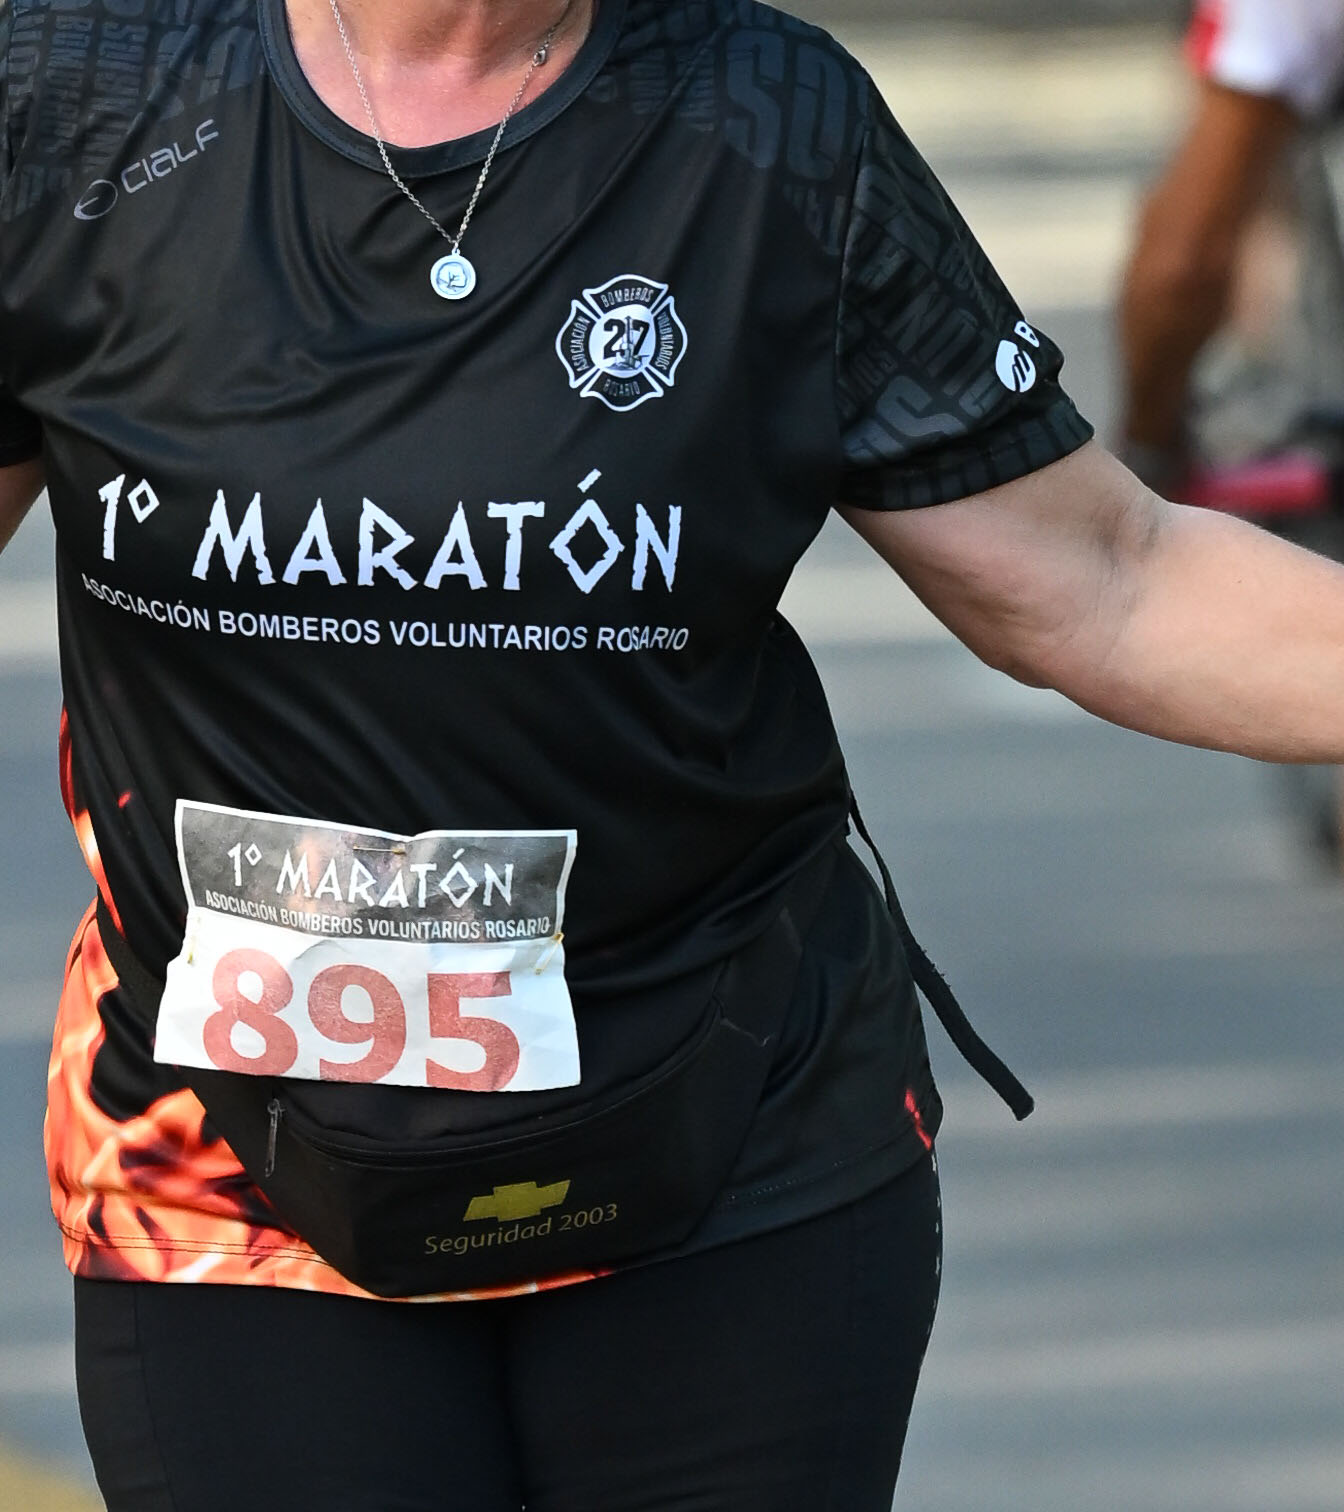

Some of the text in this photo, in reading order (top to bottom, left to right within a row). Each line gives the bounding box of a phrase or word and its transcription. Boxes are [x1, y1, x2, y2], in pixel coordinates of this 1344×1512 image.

[600, 287, 654, 308] BOMBEROS
[603, 318, 650, 360] 27
[192, 468, 682, 594] MARATÓN
[81, 573, 690, 653] ASOCIACIÓN BOMBEROS VOLUNTARIOS ROSARIO
[275, 847, 515, 909] MARATÓN
[205, 889, 551, 940] ASOCIACIÓN BOMBEROS VOLUNTARIOS ROSARIO
[203, 947, 520, 1093] 895
[425, 1203, 618, 1256] Seguridad 2003
